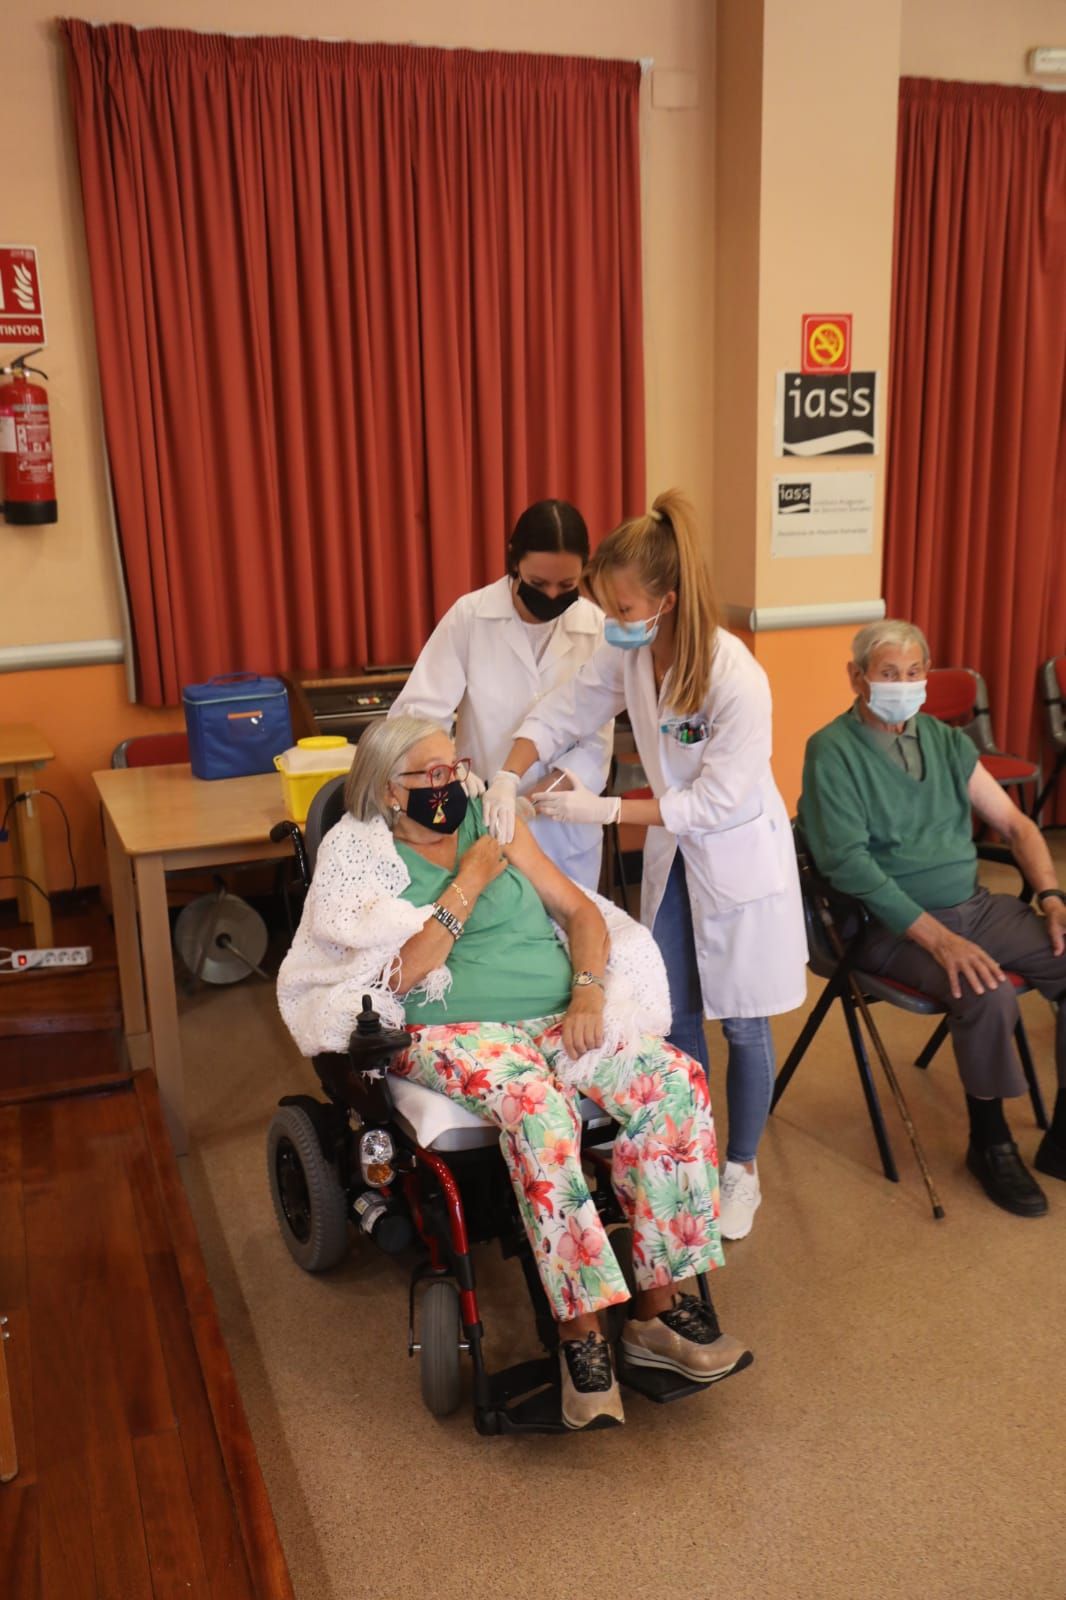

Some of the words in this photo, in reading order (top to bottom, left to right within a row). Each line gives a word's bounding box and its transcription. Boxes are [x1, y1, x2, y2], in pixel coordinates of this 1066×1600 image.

[0, 324, 41, 337] TINTOR
[788, 377, 872, 418] iass
[779, 485, 810, 501] iass
